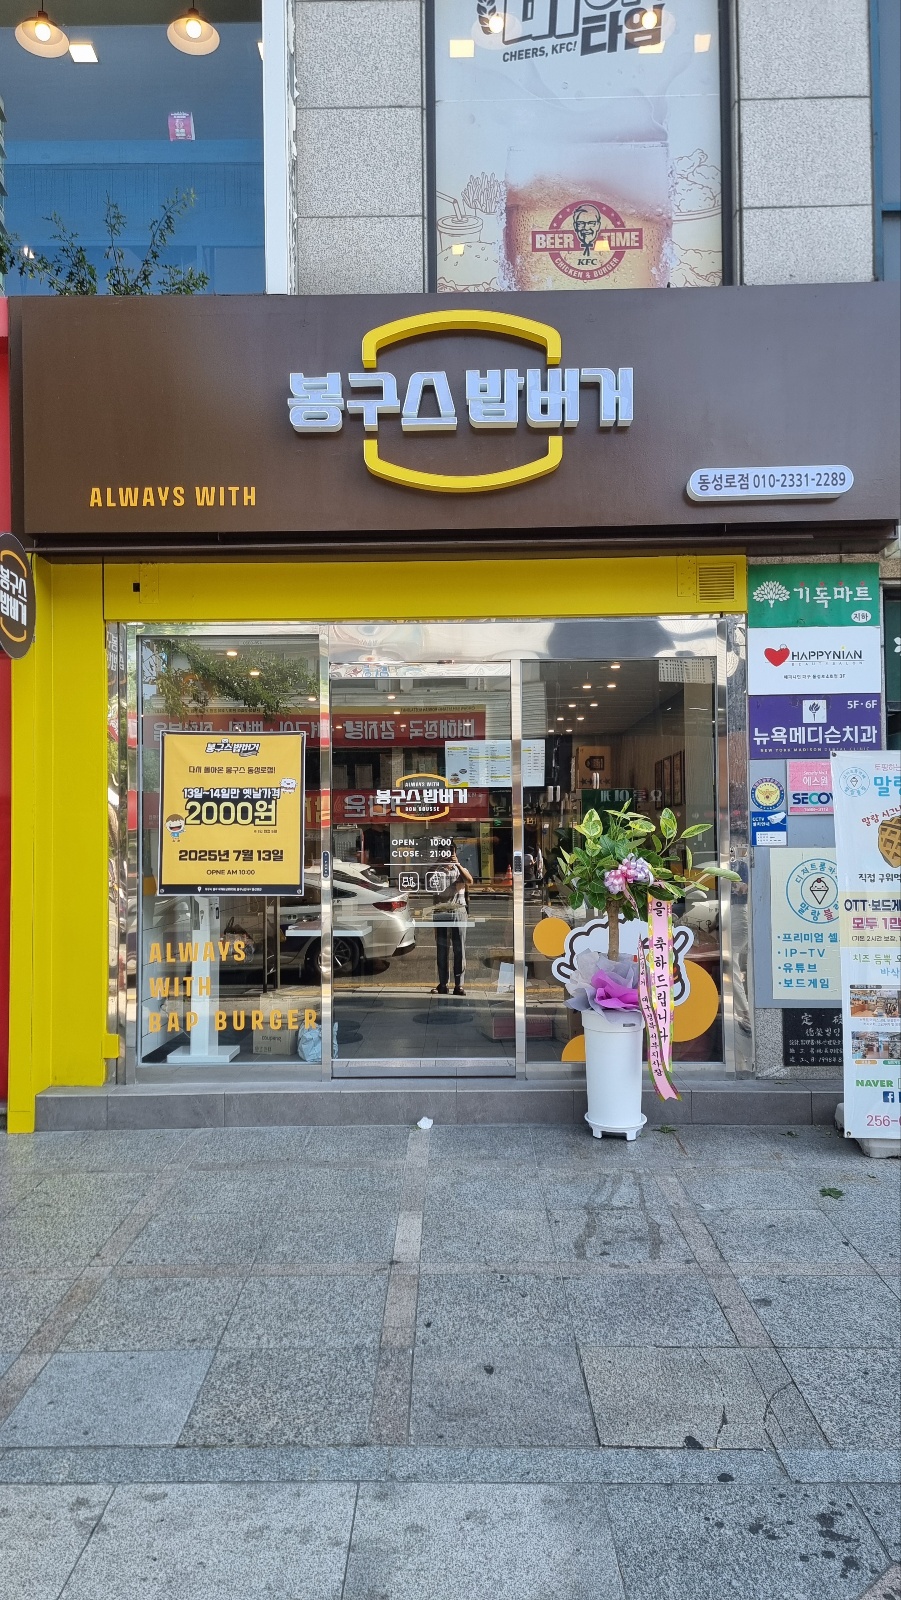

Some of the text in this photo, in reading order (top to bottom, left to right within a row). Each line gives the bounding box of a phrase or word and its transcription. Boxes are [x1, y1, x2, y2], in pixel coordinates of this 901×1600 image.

[502, 41, 577, 63] CHEERS, KFC!
[535, 231, 640, 249] BEER TIME
[554, 257, 583, 279] CHICKEN
[593, 257, 620, 278] BURGER
[577, 258, 598, 266] KFC
[698, 472, 846, 491] 동성로점 010-2331-2289
[89, 486, 256, 507] ALWAYS WITH
[793, 586, 872, 609] 기독마트
[853, 612, 869, 621] 지하
[791, 647, 863, 661] HAPPYNIAN
[753, 725, 878, 746] 뉴욕메디슨치과
[189, 766, 201, 774] 다시
[802, 776, 828, 786] 에스원
[183, 787, 281, 799] 13일~14일만 옛날가격
[376, 788, 468, 805] 봉구스밥버거
[792, 792, 834, 805] SECO
[185, 799, 277, 826] 2000원
[429, 838, 452, 847] 10:00
[178, 849, 284, 862] 2025년 7월 13일
[391, 850, 452, 858] CLOSE. 21:00
[795, 861, 838, 884] 디저트룸카
[858, 873, 876, 883] 직접
[653, 900, 666, 917] 을
[852, 917, 878, 930] 모두
[782, 932, 840, 943] 프리미엄 셀
[149, 941, 246, 963] ALWAYS
[785, 948, 826, 958] IP-TV
[852, 953, 871, 963] 치즈
[873, 954, 892, 965] 듬뿍
[783, 962, 818, 974] 유튜브
[149, 976, 212, 998] WITH
[783, 978, 829, 989] 보드게임
[149, 1009, 317, 1033] BAP BURGER
[855, 1079, 894, 1088] NAVER
